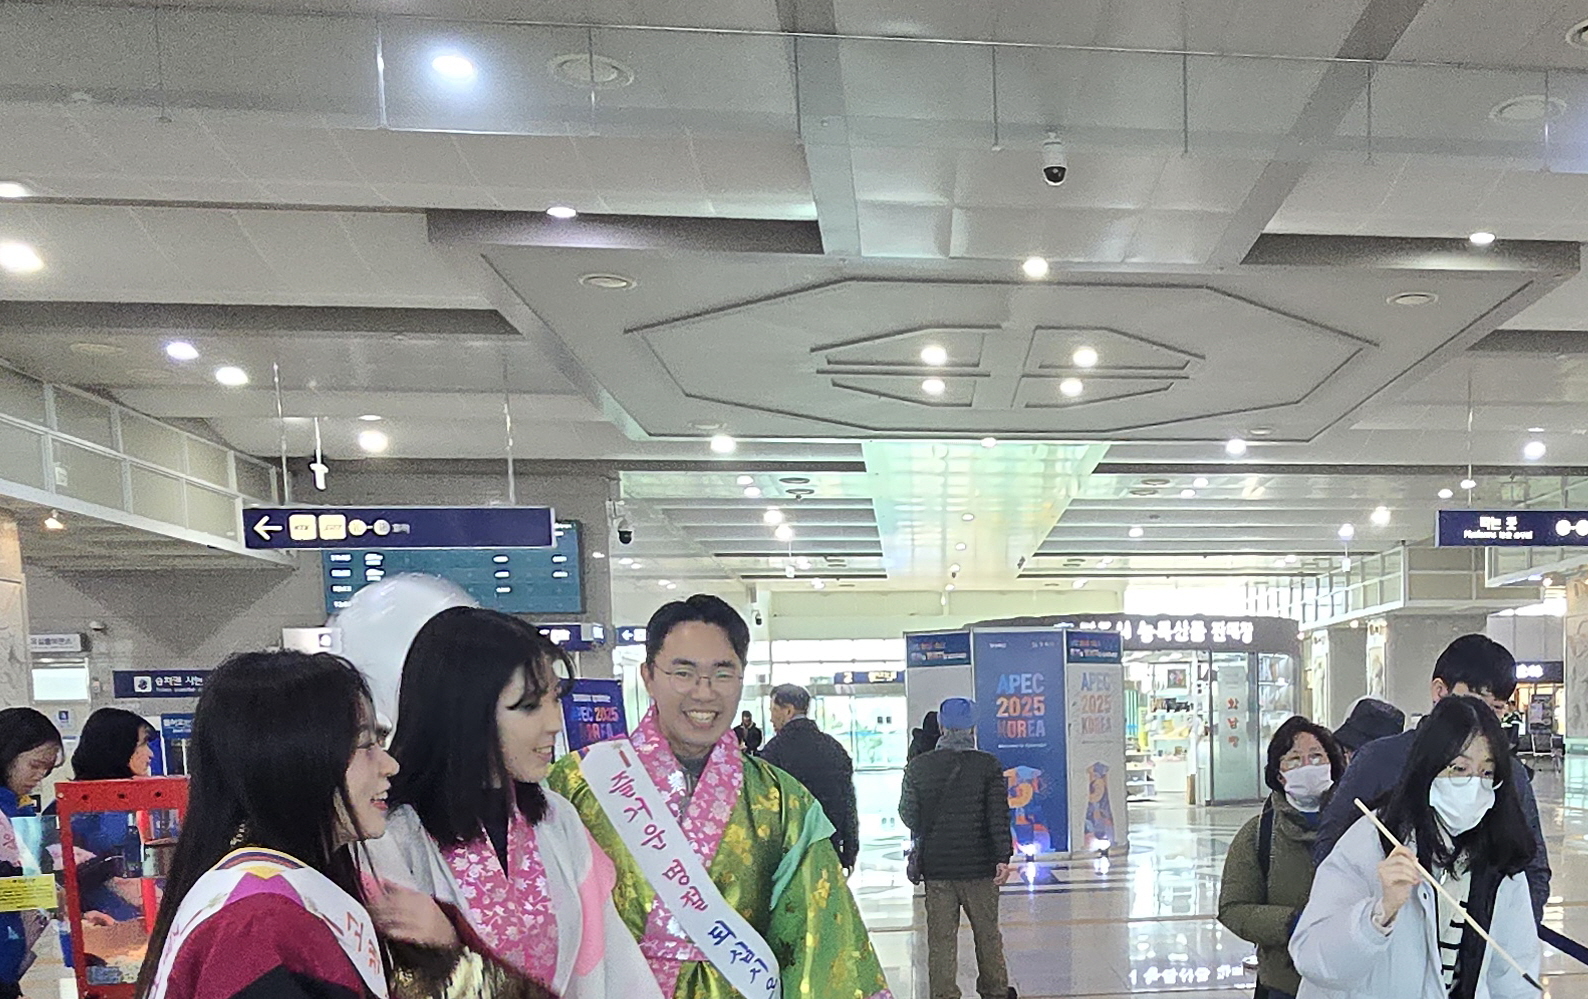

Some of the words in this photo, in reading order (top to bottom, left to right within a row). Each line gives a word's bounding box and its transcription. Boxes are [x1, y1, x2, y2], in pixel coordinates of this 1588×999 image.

[996, 673, 1045, 694] APEC
[1081, 672, 1111, 691] APEC
[996, 695, 1046, 718] 2025
[1080, 694, 1111, 714] 2025
[997, 719, 1046, 738] KOREA
[609, 770, 667, 850] 즐거운
[661, 859, 709, 912] 명절
